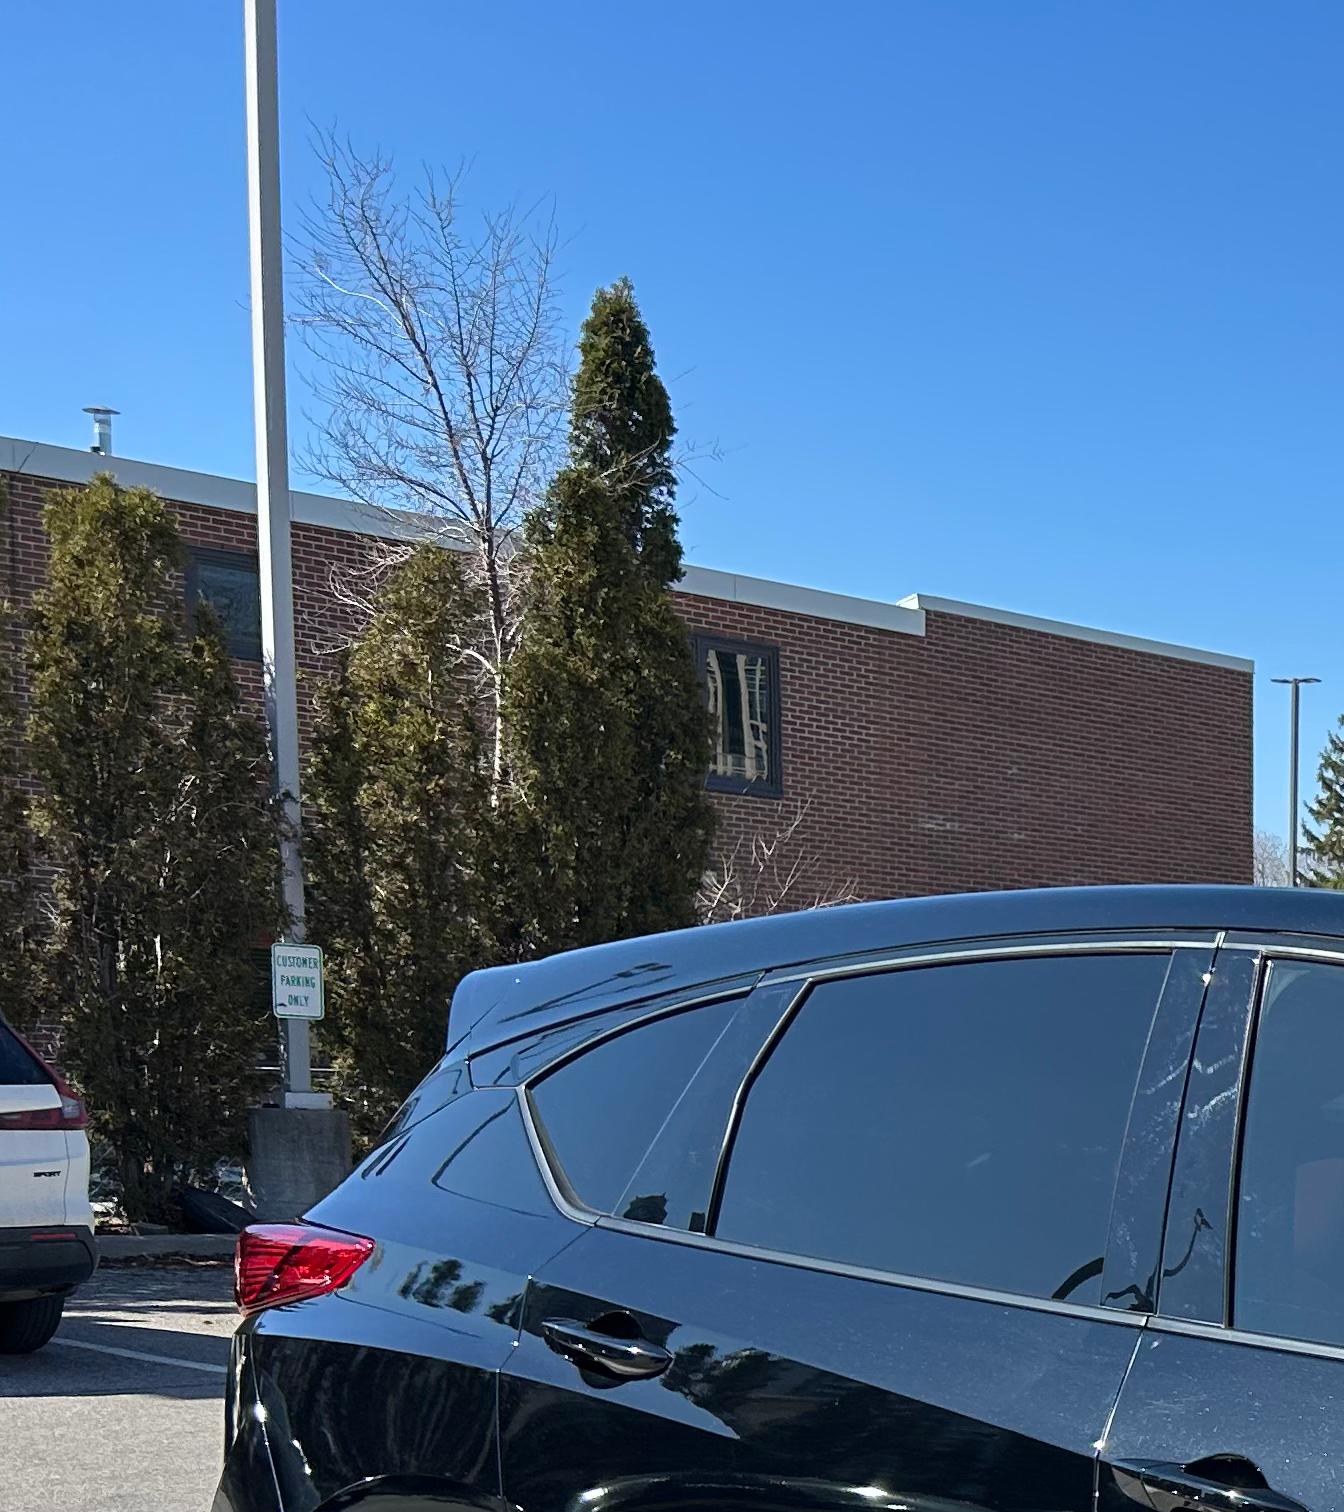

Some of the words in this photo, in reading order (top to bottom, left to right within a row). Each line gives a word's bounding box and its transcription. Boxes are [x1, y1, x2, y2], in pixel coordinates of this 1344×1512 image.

[276, 955, 319, 970] CUSTOMER
[280, 975, 316, 989] PARKING
[287, 994, 310, 1008] ONLY
